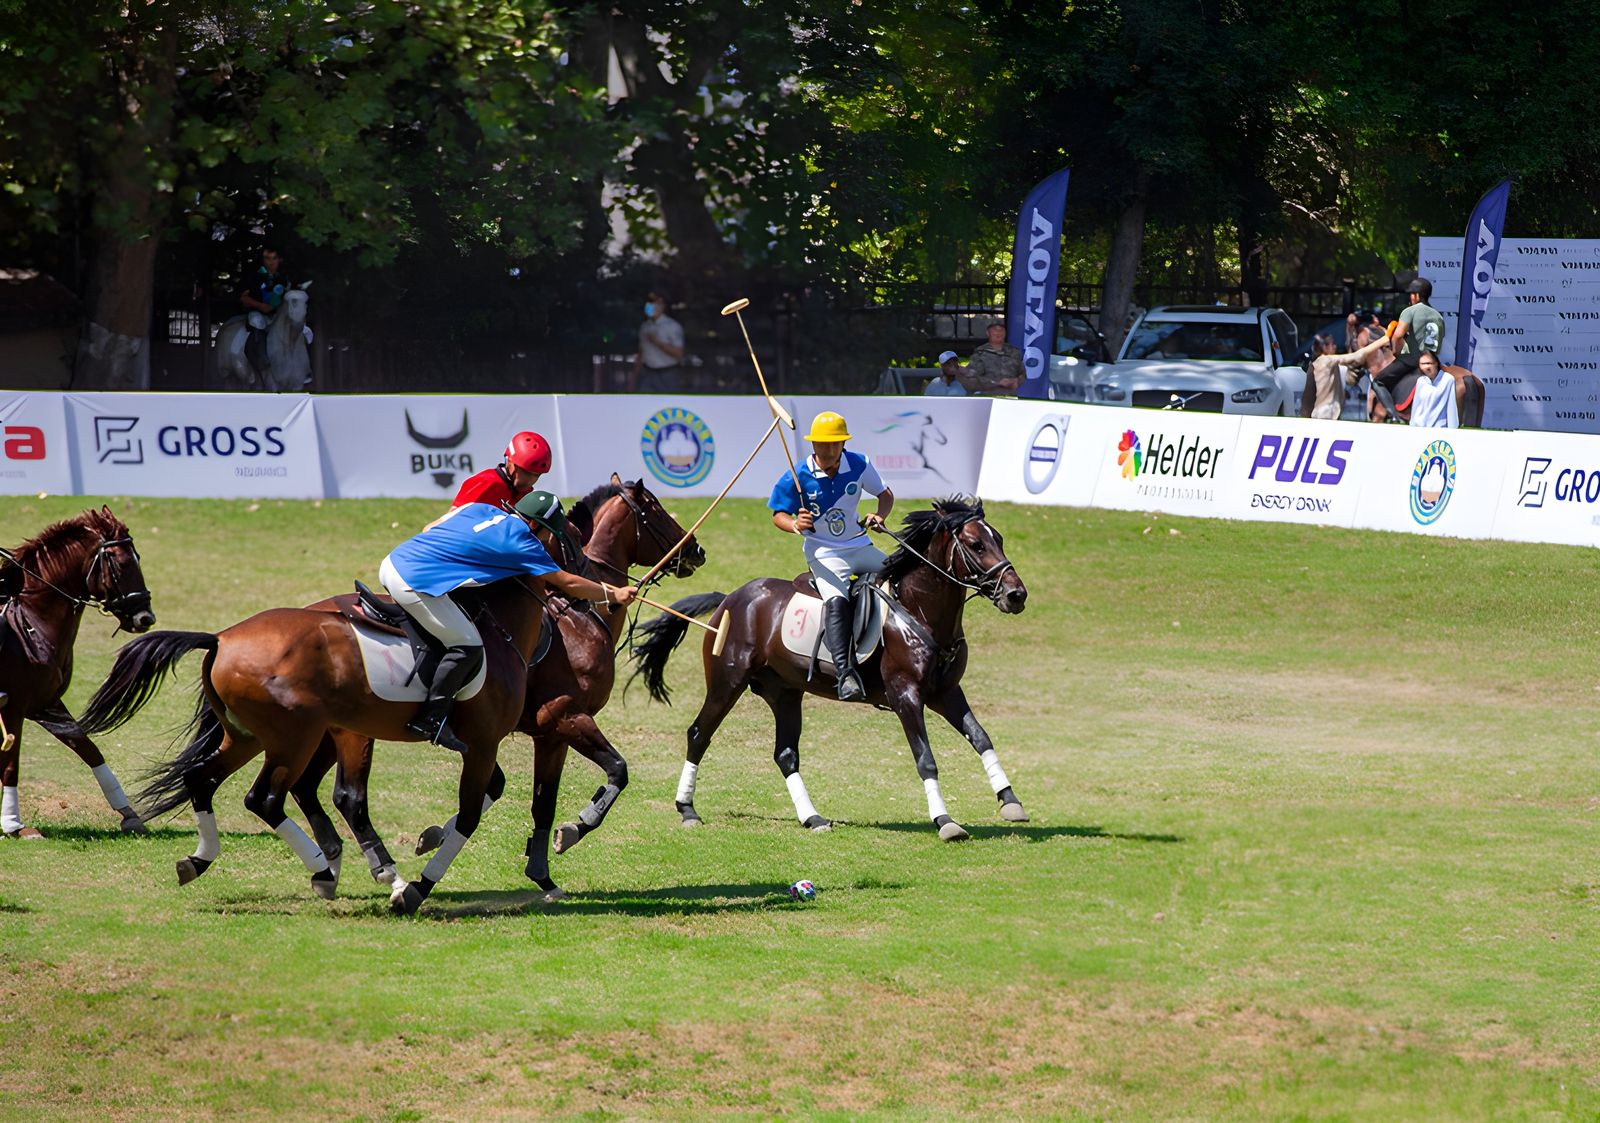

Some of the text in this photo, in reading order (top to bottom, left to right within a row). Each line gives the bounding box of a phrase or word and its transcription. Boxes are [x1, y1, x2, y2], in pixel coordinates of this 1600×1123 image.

[157, 425, 286, 457] GROSS
[1141, 433, 1224, 479] Helder
[410, 453, 474, 475] BUKA
[1247, 434, 1354, 485] PULS
[1554, 468, 1600, 504] GRO
[809, 502, 821, 517] 3
